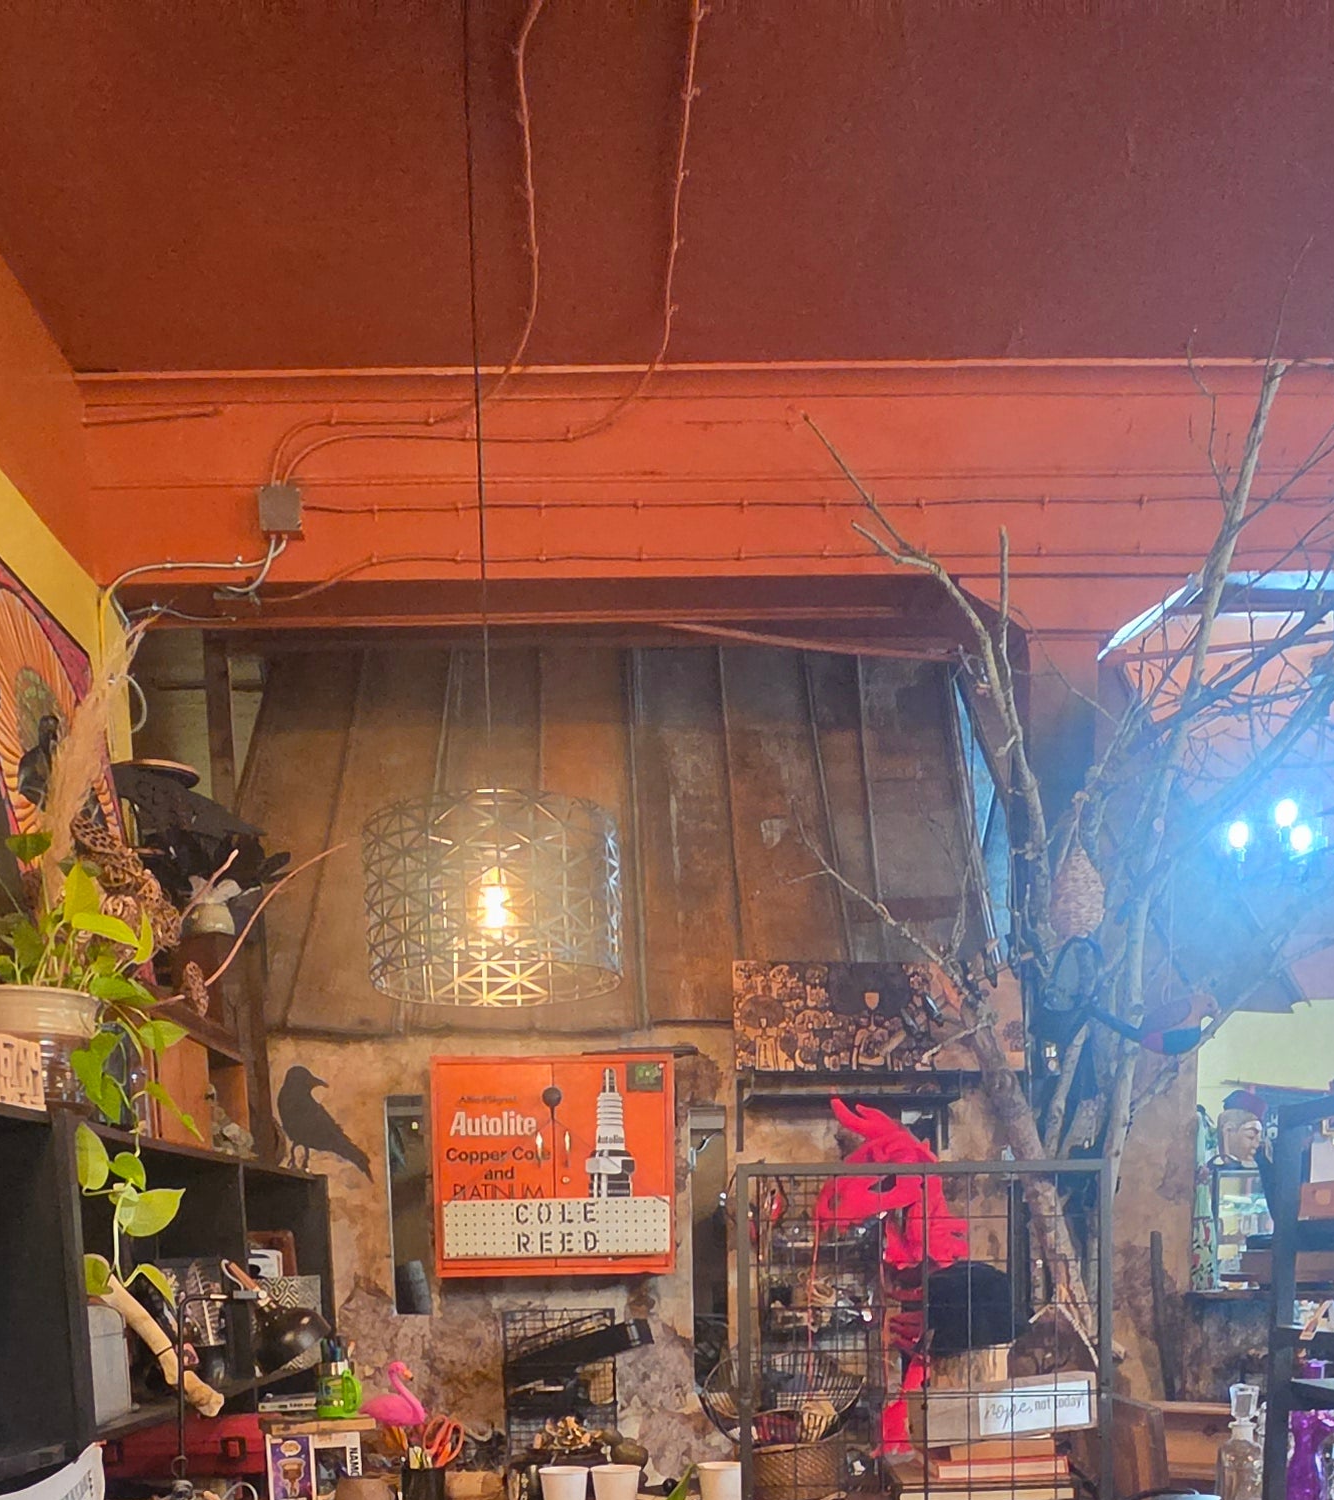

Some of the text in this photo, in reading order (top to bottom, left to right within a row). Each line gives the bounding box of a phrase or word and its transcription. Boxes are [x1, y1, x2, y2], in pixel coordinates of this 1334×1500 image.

[449, 1111, 537, 1137] Autolite
[446, 1146, 551, 1165] Copper Coe
[484, 1167, 515, 1180] and
[453, 1183, 544, 1199] PLATINUM
[515, 1202, 599, 1224] COLE
[517, 1231, 599, 1253] REED
[1035, 1397, 1052, 1411] not
